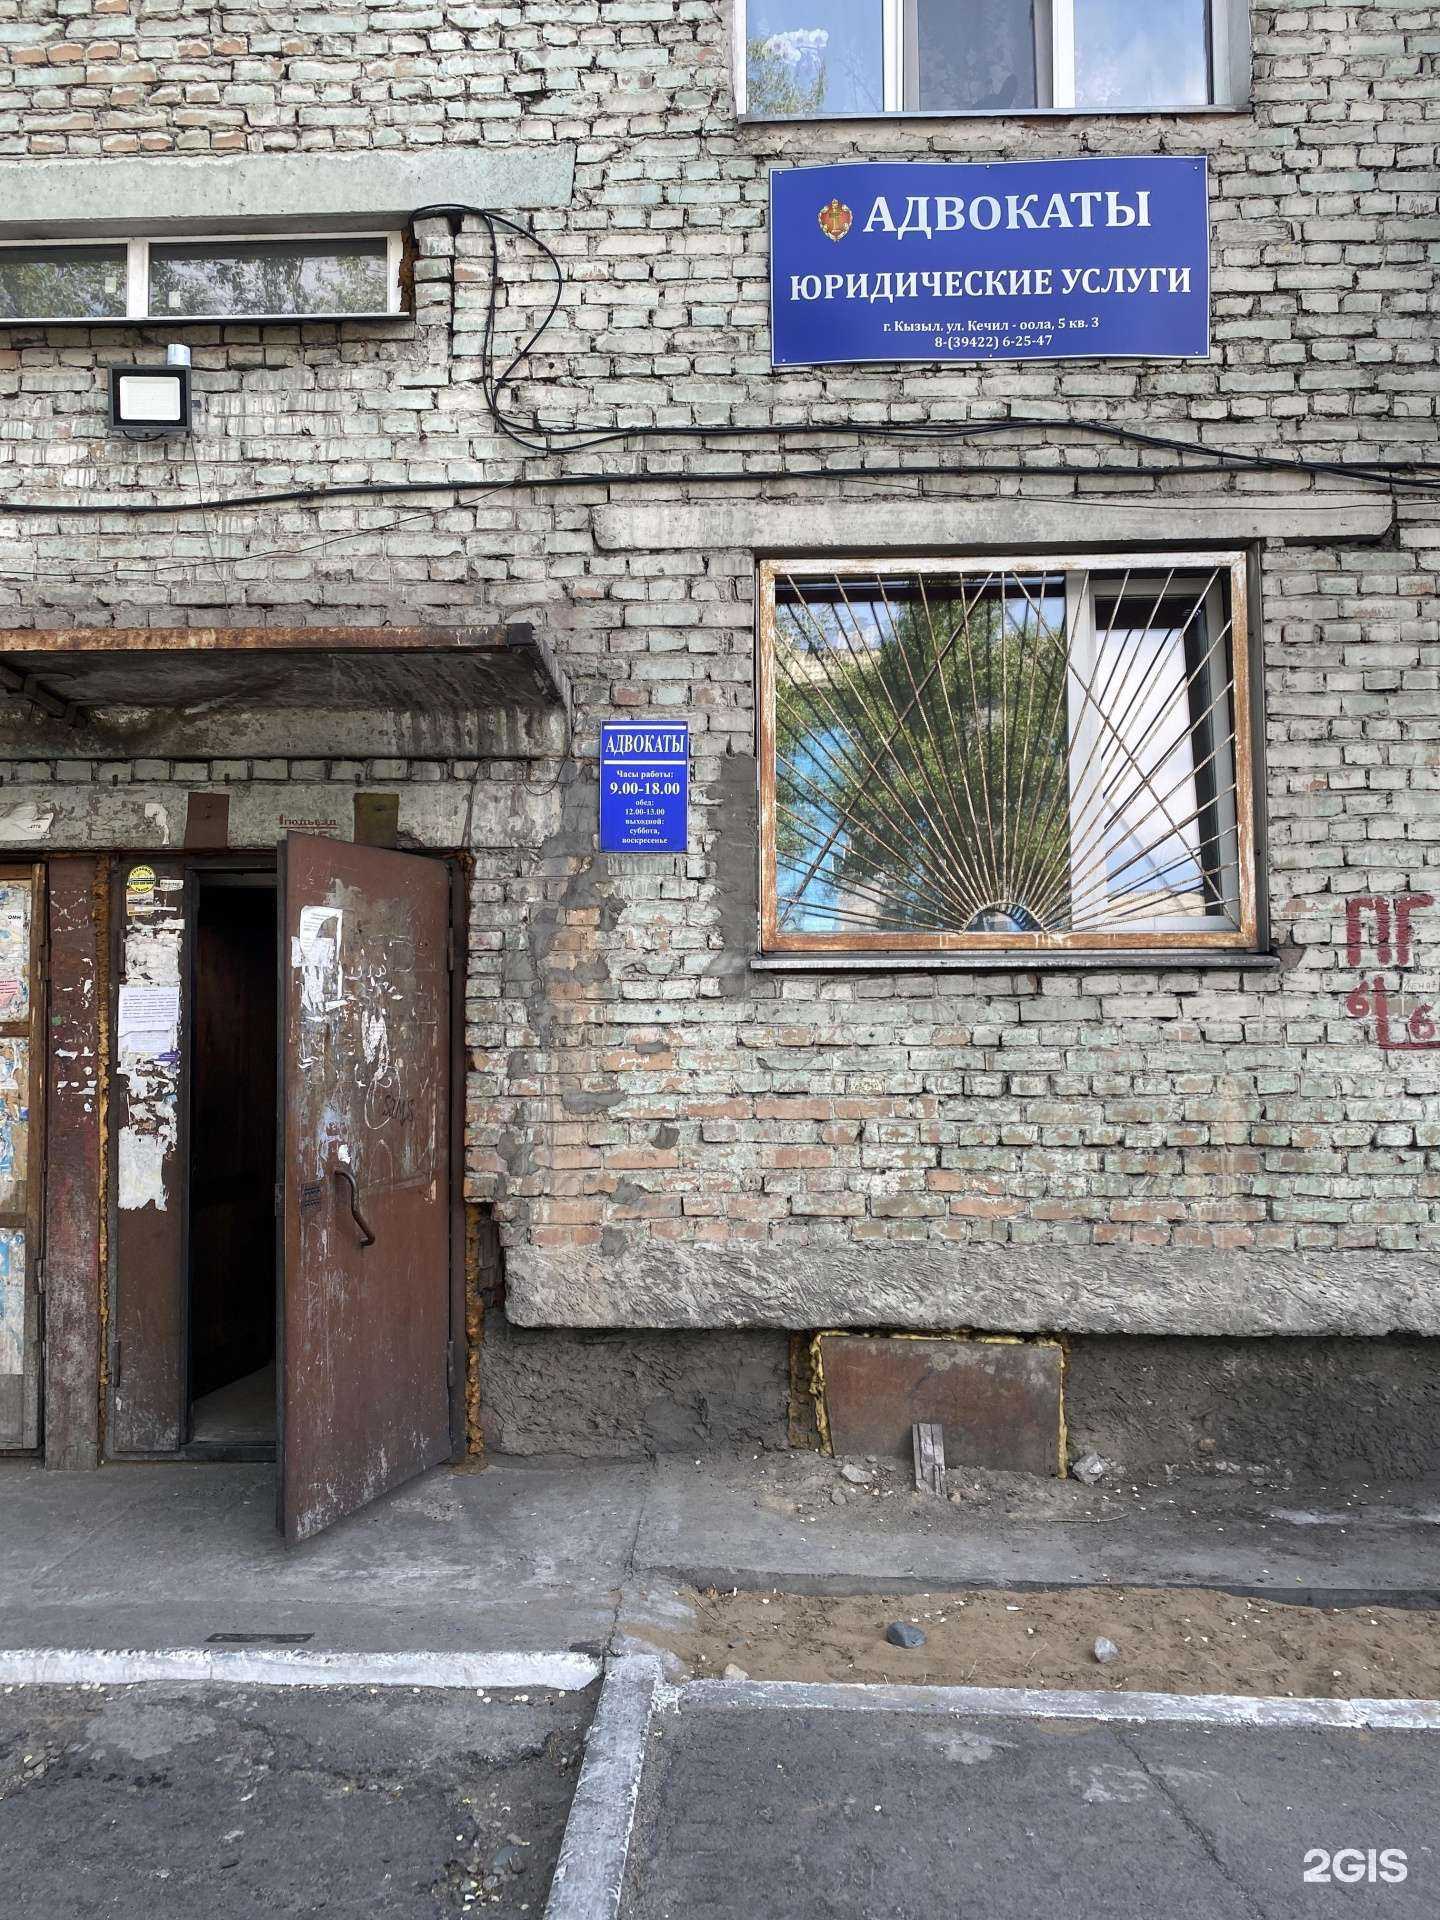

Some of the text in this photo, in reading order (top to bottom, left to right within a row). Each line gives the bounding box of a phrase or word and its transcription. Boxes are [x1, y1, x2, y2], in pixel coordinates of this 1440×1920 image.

[862, 191, 1152, 240] АДВОКАТЫ
[790, 267, 1192, 303] ЮРИДИЧЕСКИЕ УСЛУГИ
[883, 323, 891, 332] г.
[946, 322, 965, 334] ул.
[967, 320, 1009, 331] Кечил
[1019, 320, 1055, 332] оола,
[1058, 318, 1066, 329] 5
[1069, 320, 1089, 329] кв.
[1091, 317, 1100, 328] 3
[934, 335, 1053, 350] 8-(39422) 6-25-47
[605, 734, 685, 756] АДВОКАТЫ
[616, 770, 674, 780] Часы работы:
[609, 782, 680, 795] 9.00-18.00
[625, 808, 665, 816] 12.00-13.00
